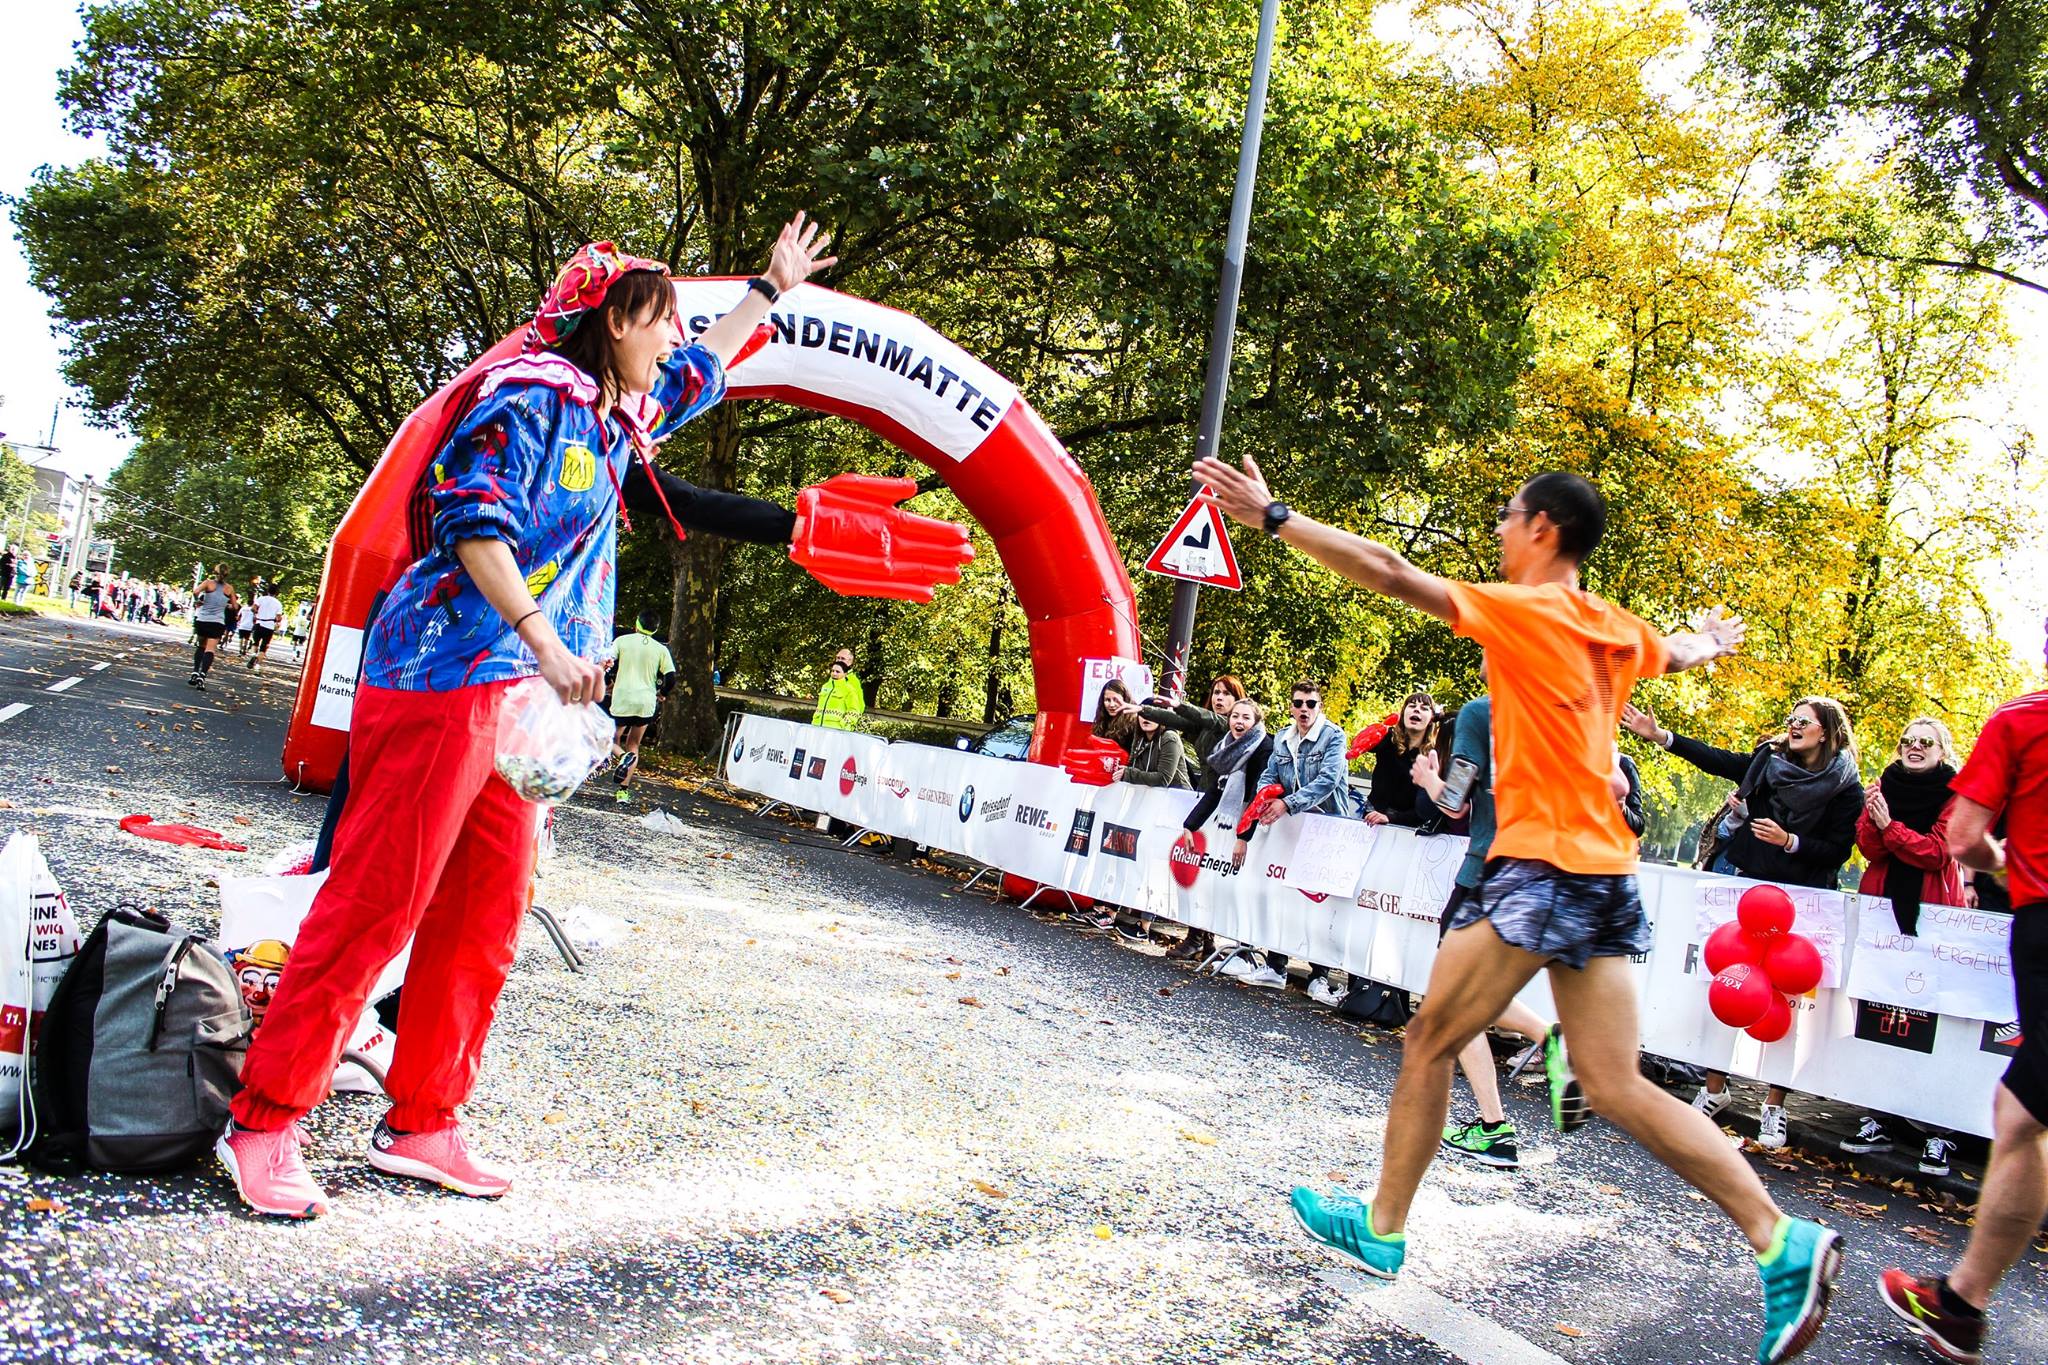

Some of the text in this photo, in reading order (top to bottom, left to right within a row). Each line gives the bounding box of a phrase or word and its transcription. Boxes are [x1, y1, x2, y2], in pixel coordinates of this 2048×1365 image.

[688, 312, 1001, 432] SNDENMATTE
[333, 673, 355, 685] Rhei
[1092, 662, 1127, 681] EBK
[766, 748, 784, 764] REWE
[1015, 804, 1049, 830] REWE
[1921, 906, 2009, 938] SCHMERZ
[1874, 929, 1915, 952] WIRD
